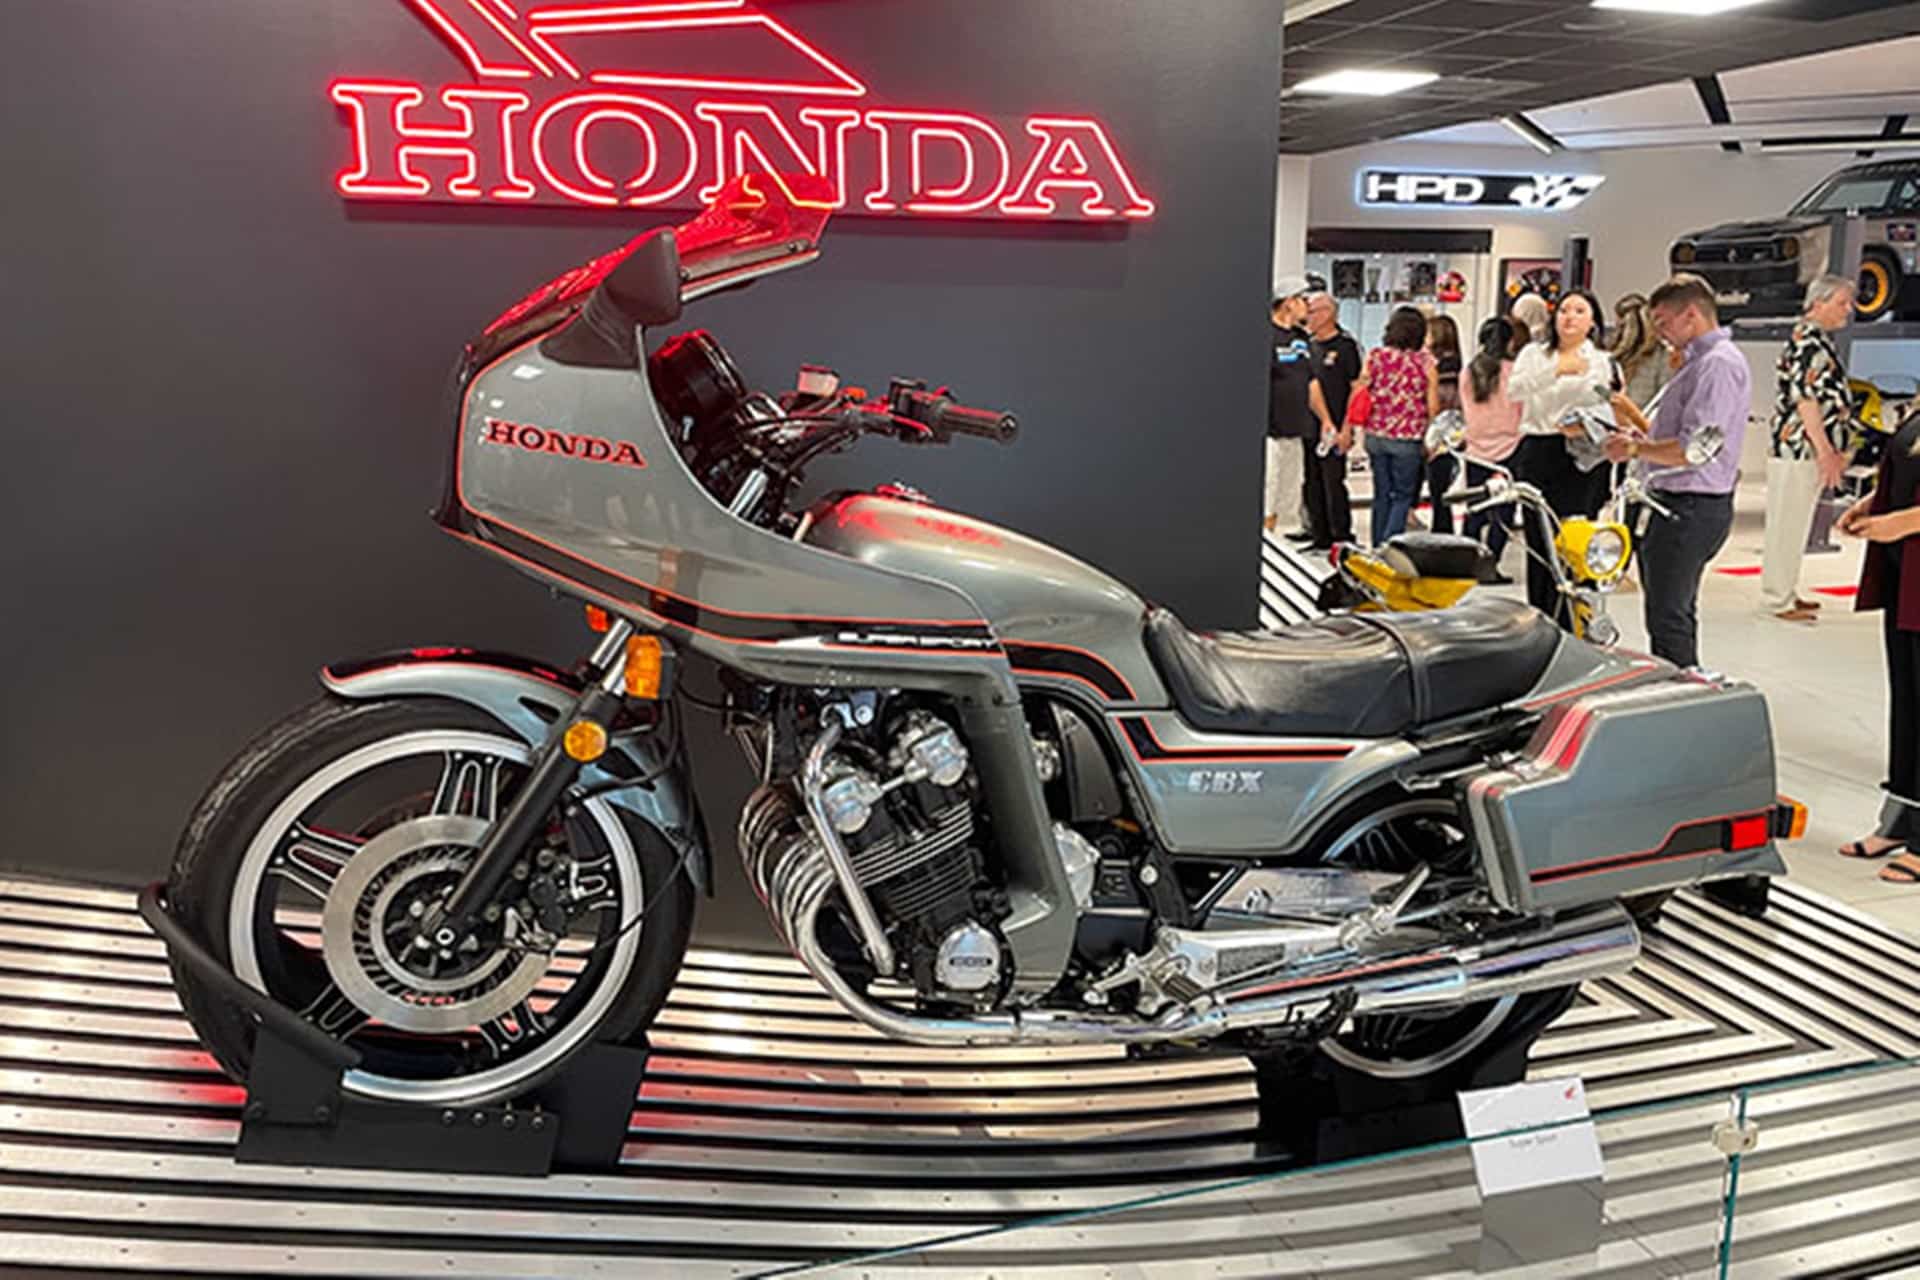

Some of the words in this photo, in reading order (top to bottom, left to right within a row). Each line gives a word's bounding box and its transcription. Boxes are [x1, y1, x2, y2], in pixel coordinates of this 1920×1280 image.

[331, 82, 1156, 218] HONDA
[1366, 173, 1485, 203] HPD
[484, 419, 648, 469] HONDA
[1188, 770, 1264, 792] CBX
